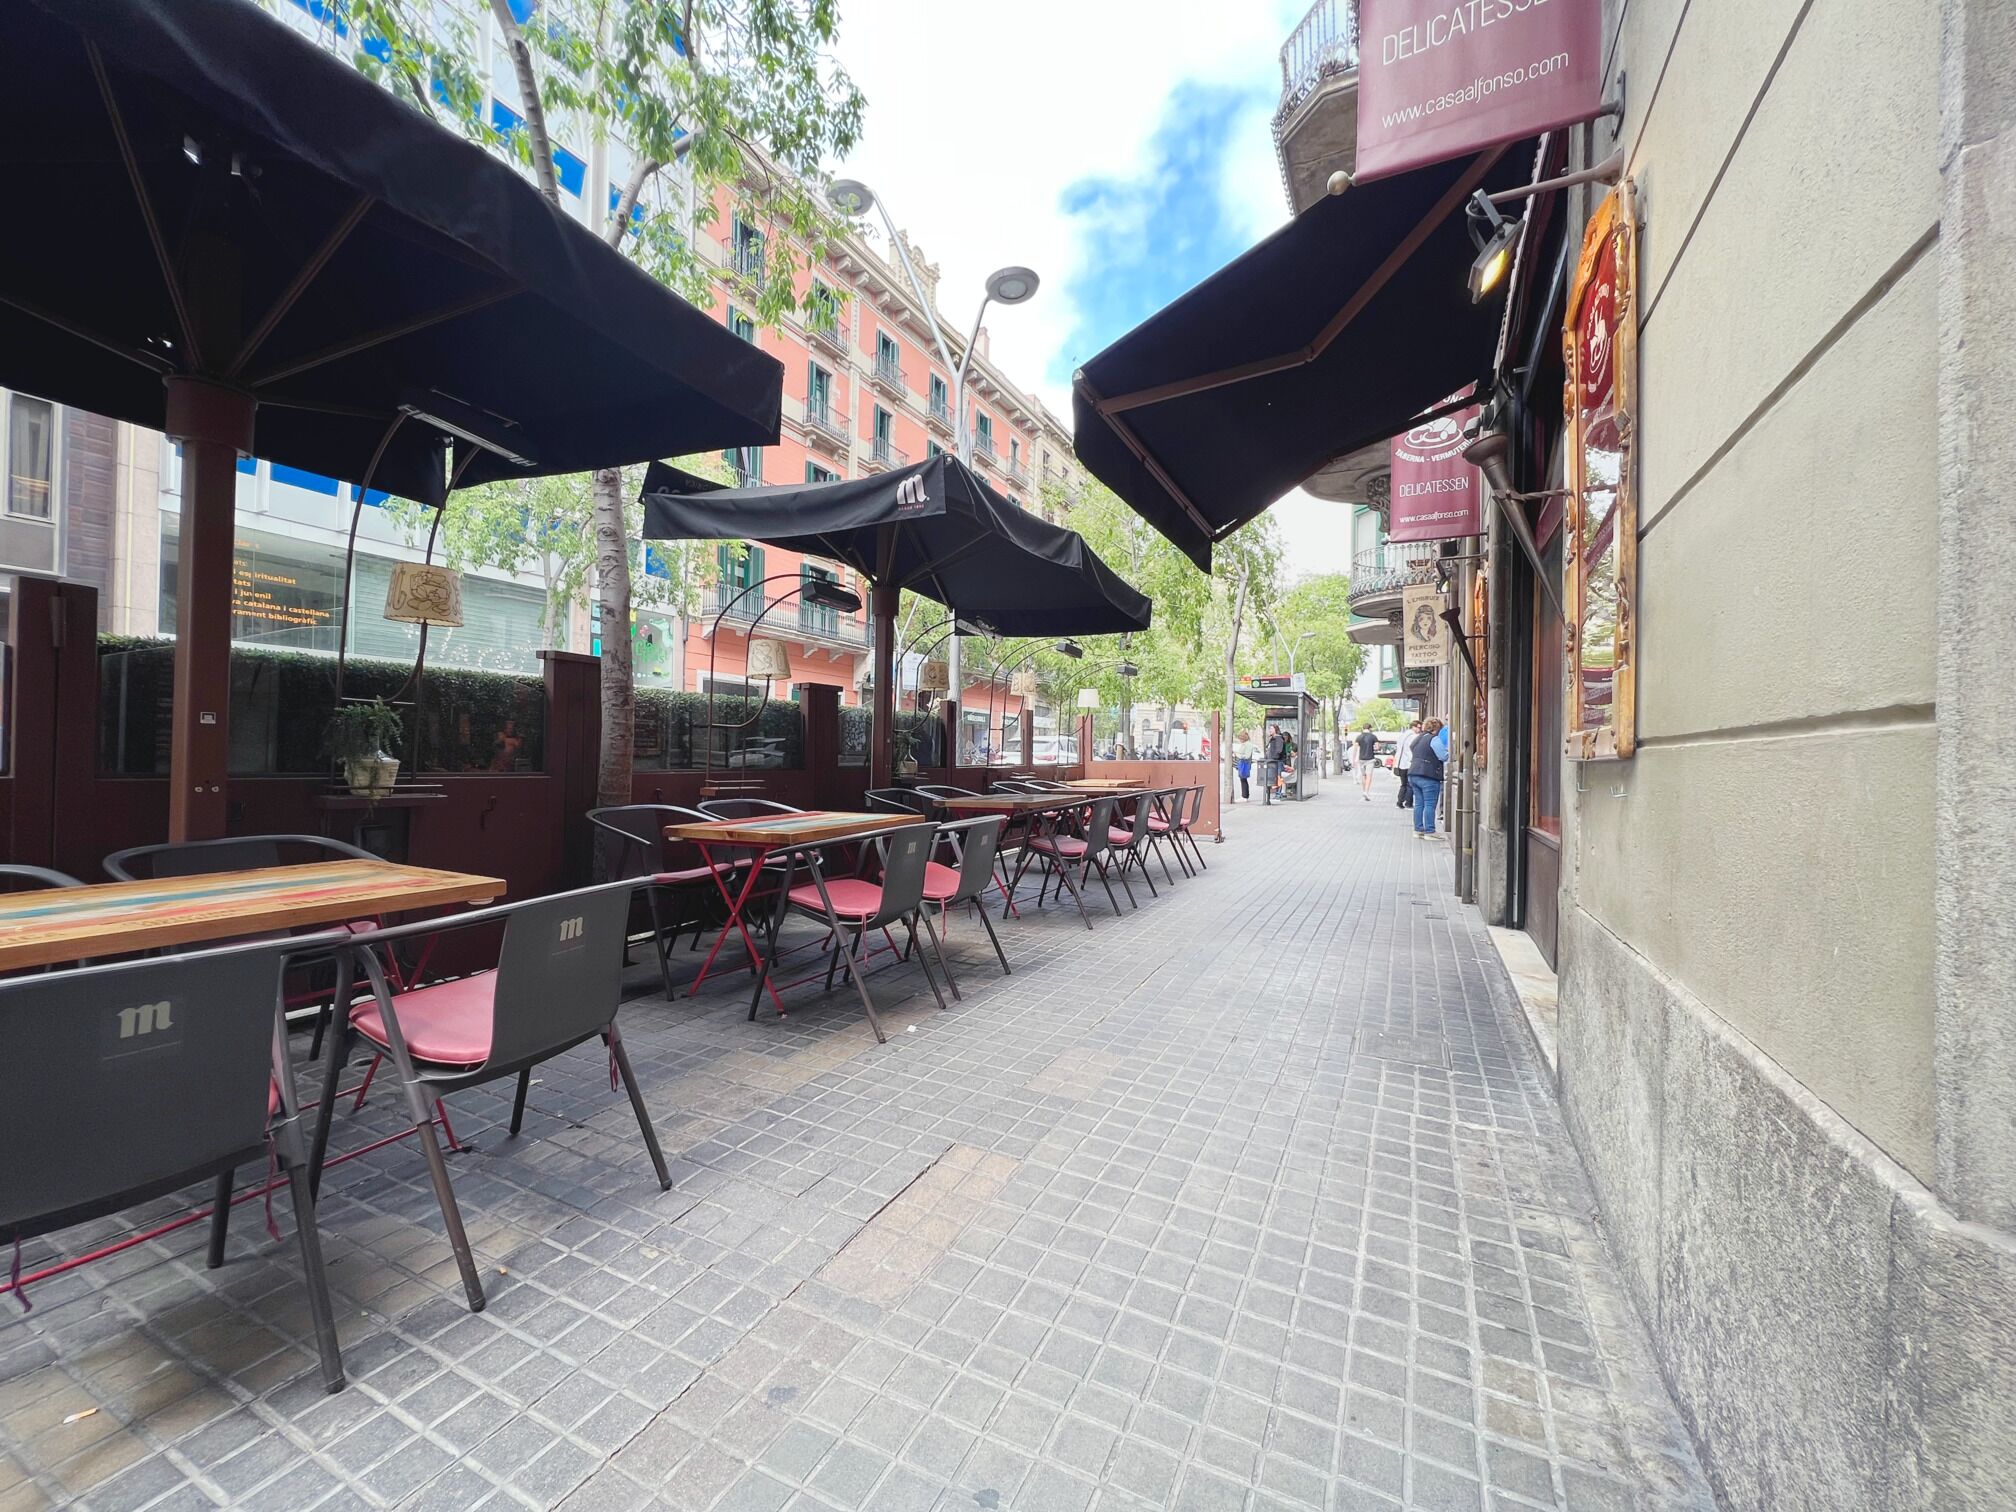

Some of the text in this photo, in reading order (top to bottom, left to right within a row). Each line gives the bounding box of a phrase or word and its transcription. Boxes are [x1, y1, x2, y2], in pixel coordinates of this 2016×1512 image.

[1382, 0, 1549, 66] DELICATES
[1381, 51, 1569, 129] www.casaalfonso.com
[1394, 448, 1425, 463] TABERNA
[1399, 476, 1469, 498] DELICATESSEN
[243, 600, 281, 611] catalana
[288, 606, 330, 618] castellana
